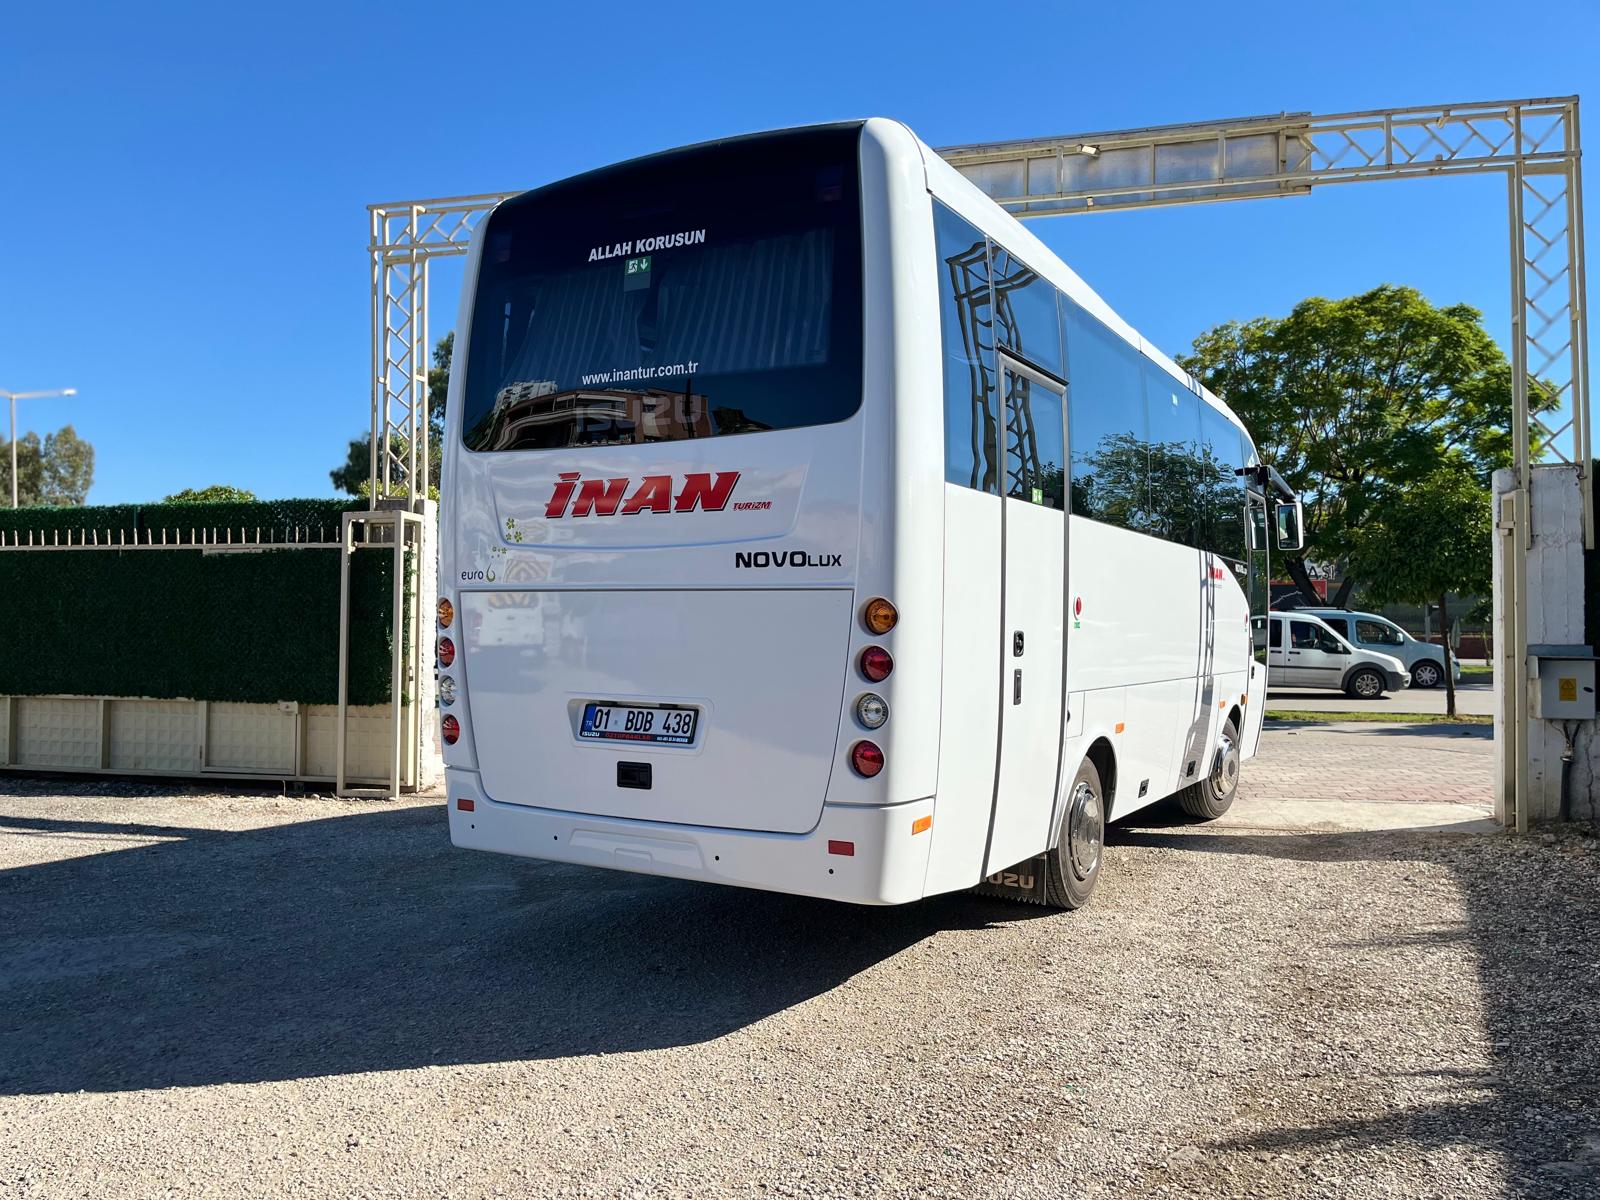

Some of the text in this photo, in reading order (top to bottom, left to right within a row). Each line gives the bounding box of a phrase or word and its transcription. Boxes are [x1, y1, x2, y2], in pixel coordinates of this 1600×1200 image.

[588, 229, 706, 262] ALLAH KORUSUN
[581, 360, 699, 386] www.inantur.com.tr
[593, 709, 692, 734] 01 BDB 438
[984, 870, 1035, 890] UZU
